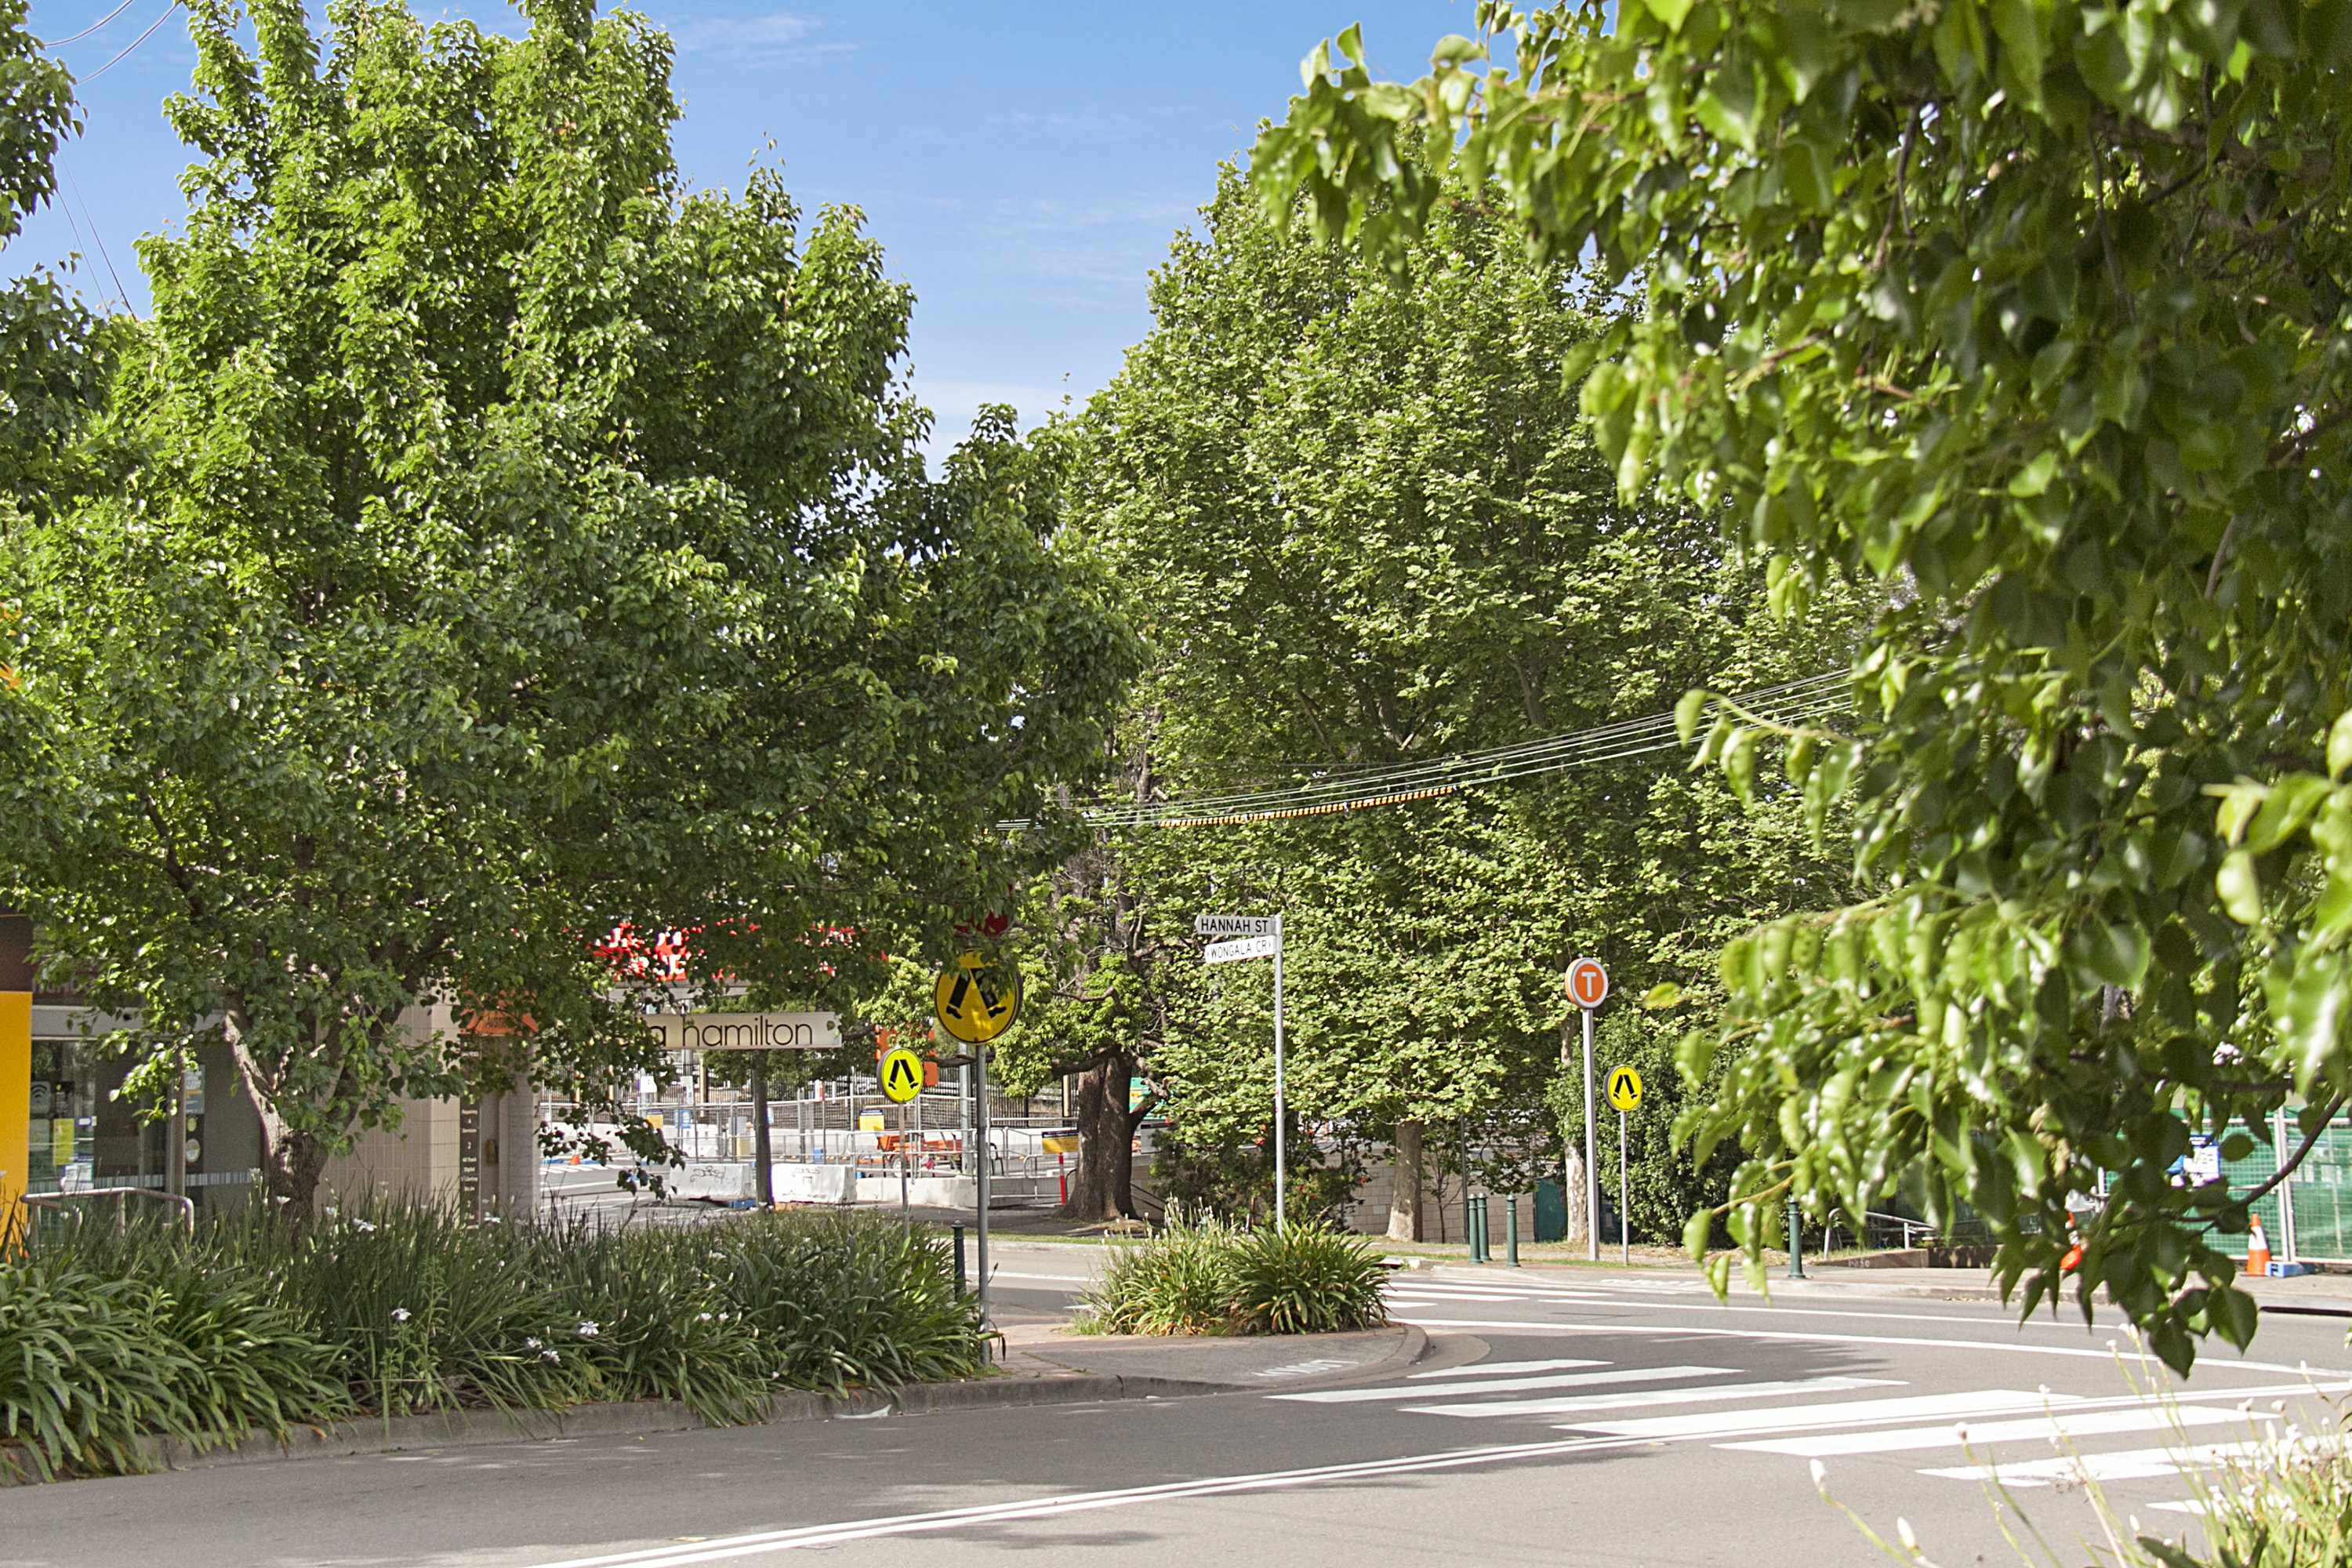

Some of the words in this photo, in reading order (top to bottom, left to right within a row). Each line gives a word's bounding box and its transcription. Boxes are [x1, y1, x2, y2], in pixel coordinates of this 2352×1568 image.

[1201, 918, 1250, 932] HANNAH
[1255, 920, 1269, 933] ST
[1210, 942, 1252, 959] WONGALA
[1256, 939, 1267, 953] CR
[1581, 971, 1596, 997] T
[682, 1015, 813, 1047] hamilton
